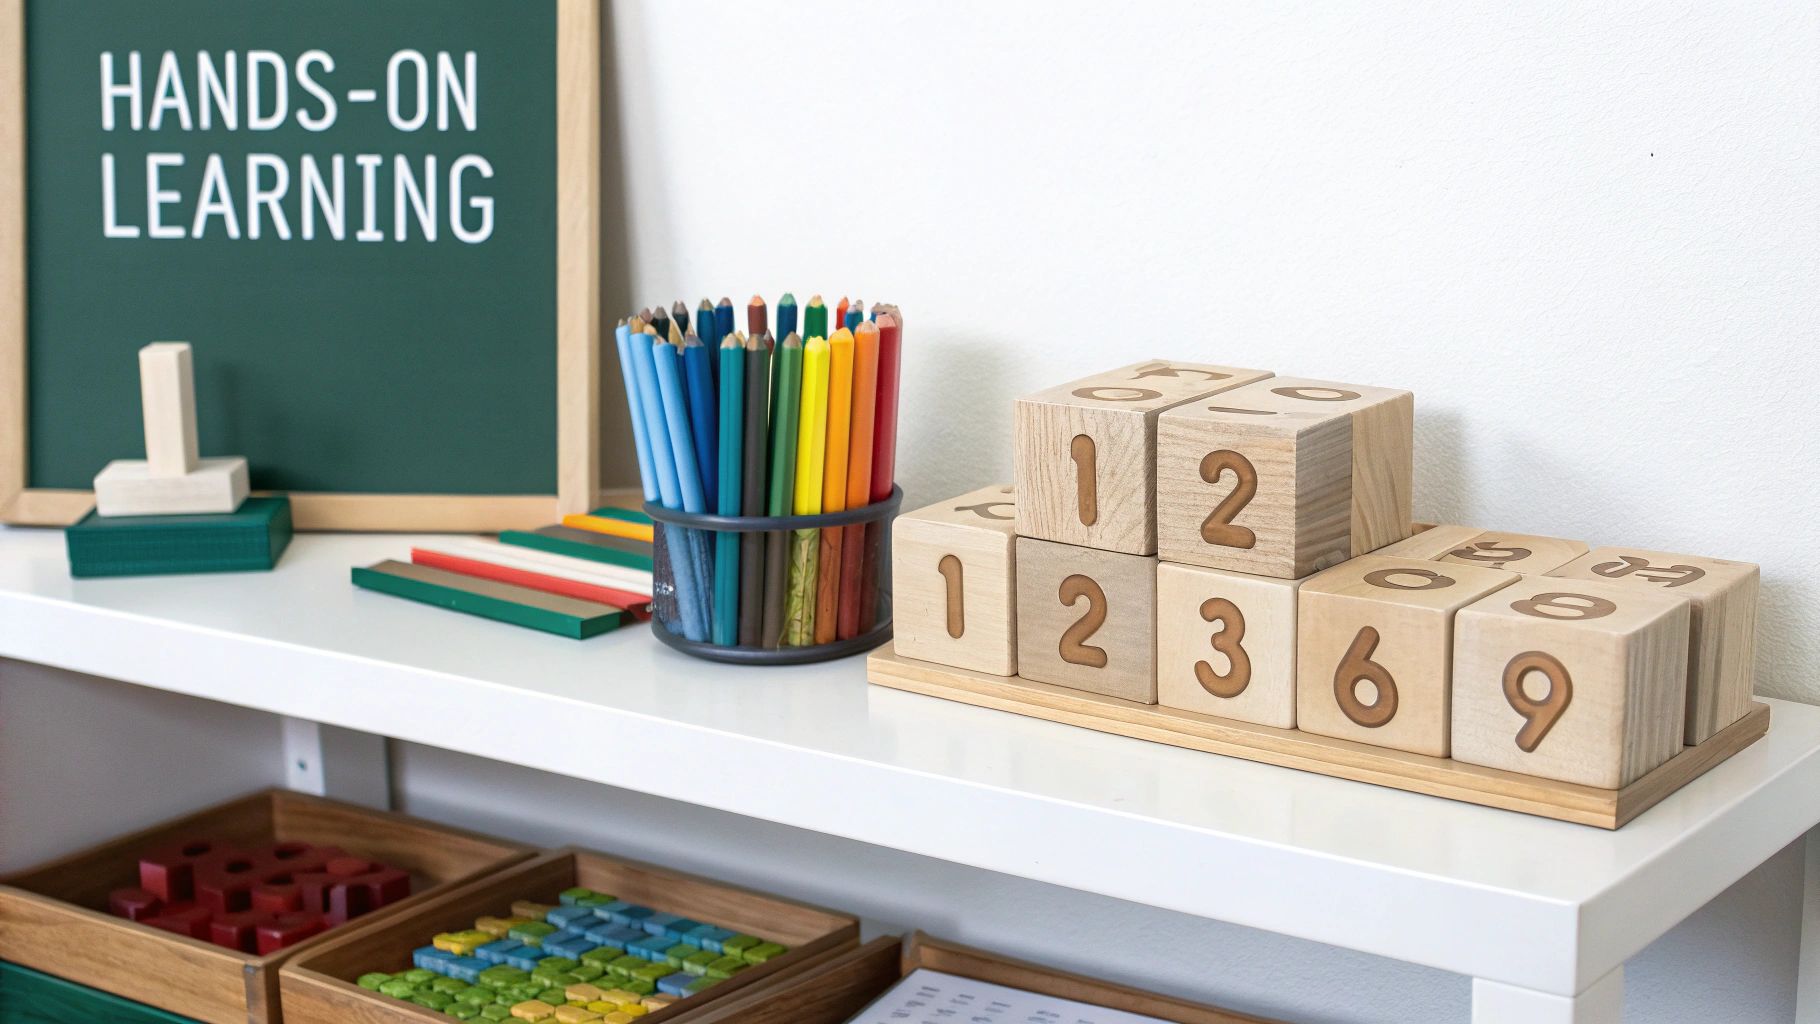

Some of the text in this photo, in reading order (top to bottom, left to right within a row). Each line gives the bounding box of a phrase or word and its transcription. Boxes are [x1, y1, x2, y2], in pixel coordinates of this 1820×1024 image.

[100, 49, 478, 132] HANDS-ON
[101, 153, 495, 243] LEARNING
[1070, 434, 1097, 527] 1
[1199, 449, 1258, 550] 2
[938, 553, 964, 639] 1
[1058, 574, 1108, 668] 2
[1194, 597, 1252, 698] 3
[1333, 625, 1399, 729] 6
[1502, 650, 1574, 753] 9
